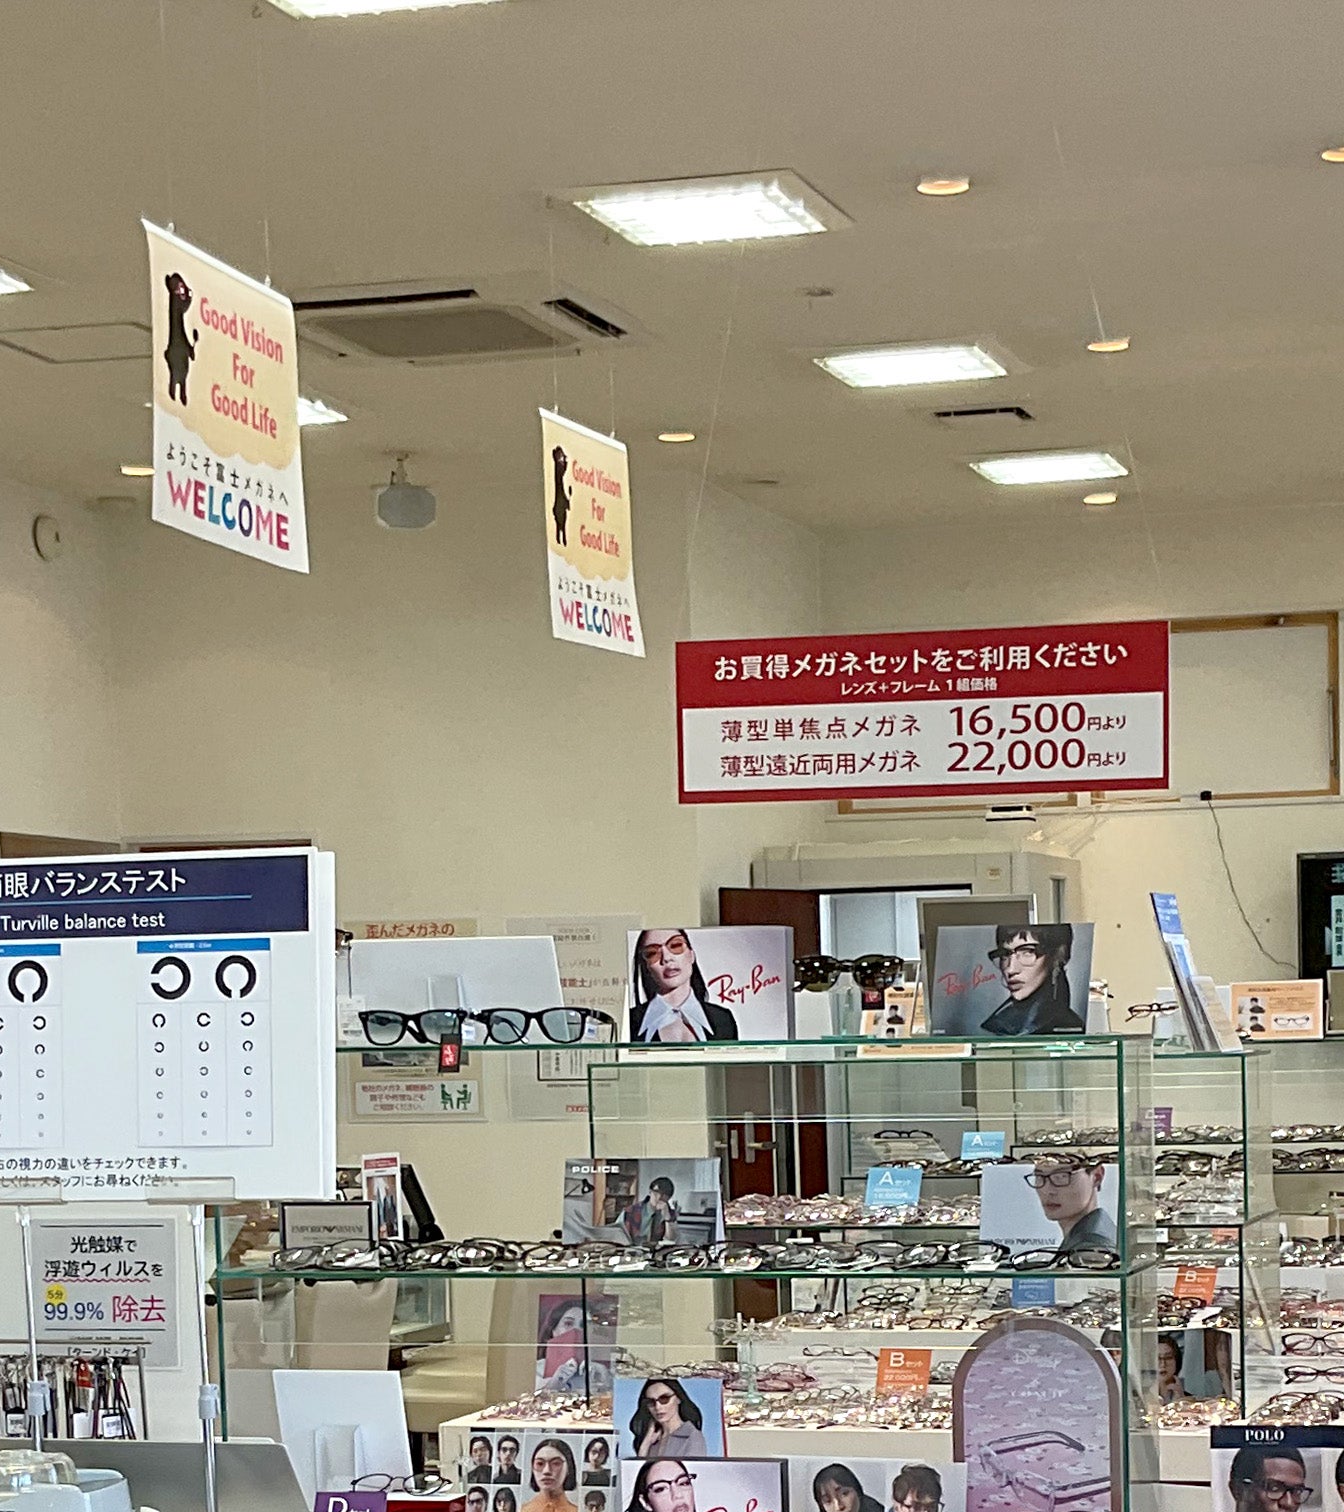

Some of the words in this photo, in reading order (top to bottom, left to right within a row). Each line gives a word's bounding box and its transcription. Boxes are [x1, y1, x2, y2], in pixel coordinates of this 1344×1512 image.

[200, 297, 238, 342] Good
[241, 317, 284, 364] Vision
[232, 352, 256, 389] For
[211, 384, 249, 426] Good
[252, 402, 278, 441] Life
[166, 441, 289, 506] ようこそ富士メガネへ
[572, 459, 595, 485] Good
[597, 468, 622, 500] Vision
[167, 471, 290, 551] WELCOME
[591, 499, 606, 522] For
[579, 525, 602, 551] Good
[602, 532, 621, 559] Life
[558, 598, 635, 643] WELCOME
[714, 642, 1129, 682] お買得メガネセットをご利用ください
[720, 715, 922, 743] 薄型単焦点メガネ
[719, 750, 921, 778] 薄型遠近両用メガネ
[0, 914, 59, 933] Turville
[64, 912, 126, 931] balance
[131, 912, 166, 929] test
[365, 923, 455, 938] 歪んだメガネの
[708, 964, 782, 1005] Ray-Ban
[938, 964, 997, 998] Ray-Ban
[571, 1166, 620, 1174] POLICE
[70, 1235, 137, 1254] 光触媒で
[44, 1260, 163, 1278] 浮遊ウィルスを
[44, 1302, 104, 1321] 99.9%
[112, 1294, 166, 1323] 除去
[1245, 1430, 1284, 1441] POLO
